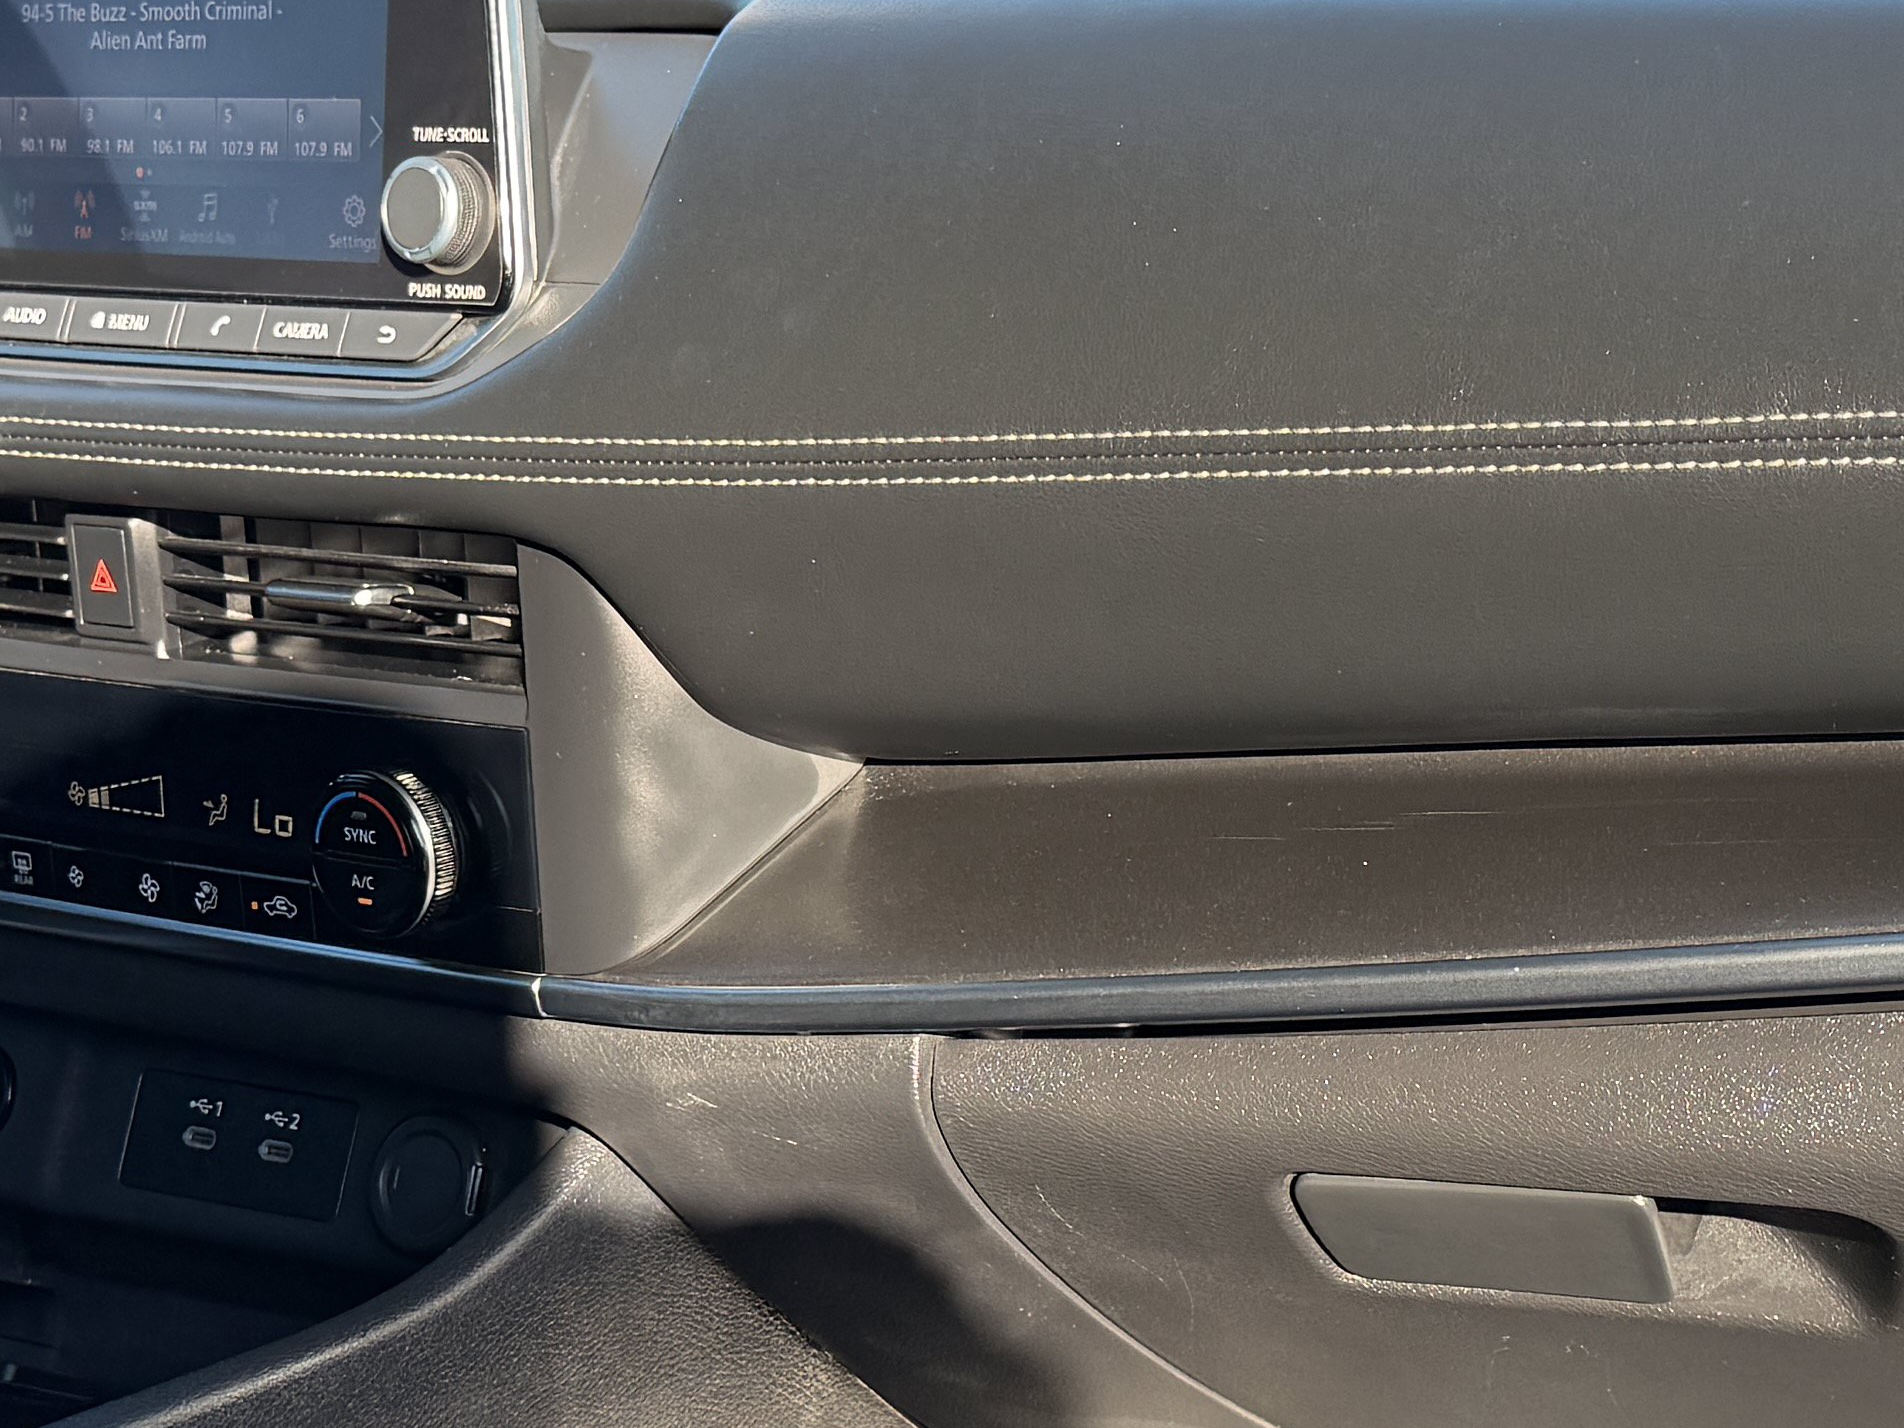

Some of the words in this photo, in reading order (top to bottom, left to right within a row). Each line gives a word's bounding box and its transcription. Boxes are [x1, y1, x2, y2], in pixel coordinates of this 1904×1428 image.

[21, 3, 54, 23] 94-5
[56, 3, 86, 22] The
[90, 2, 127, 22] Buzz
[139, 0, 201, 22] Smooth
[204, 0, 273, 21] Criminal
[89, 29, 131, 51] Alien
[134, 29, 163, 51] Ant
[167, 29, 207, 51] Farm
[19, 106, 28, 122] 2
[86, 107, 94, 122] 3
[153, 107, 162, 122] 4
[224, 108, 232, 123] 5
[296, 108, 305, 123] 6
[50, 138, 67, 153] FM
[86, 138, 110, 154] 98.1
[117, 139, 134, 154] FM
[152, 139, 182, 155] 106.1
[189, 140, 207, 155] FM
[222, 140, 254, 156] 107.9
[260, 141, 278, 156] FM
[295, 141, 327, 157] 107.9
[334, 142, 352, 157] FM
[74, 225, 92, 239] FM
[327, 233, 378, 253] Settings
[408, 282, 441, 299] PUSH
[444, 283, 487, 300] SOUND
[2, 306, 47, 325] AUDIO
[107, 313, 150, 331] MENU
[273, 321, 329, 340] CAMERA
[343, 826, 377, 845] SYNC
[351, 873, 375, 890] A/C
[216, 1100, 223, 1117] 1
[289, 1113, 300, 1130] 2
